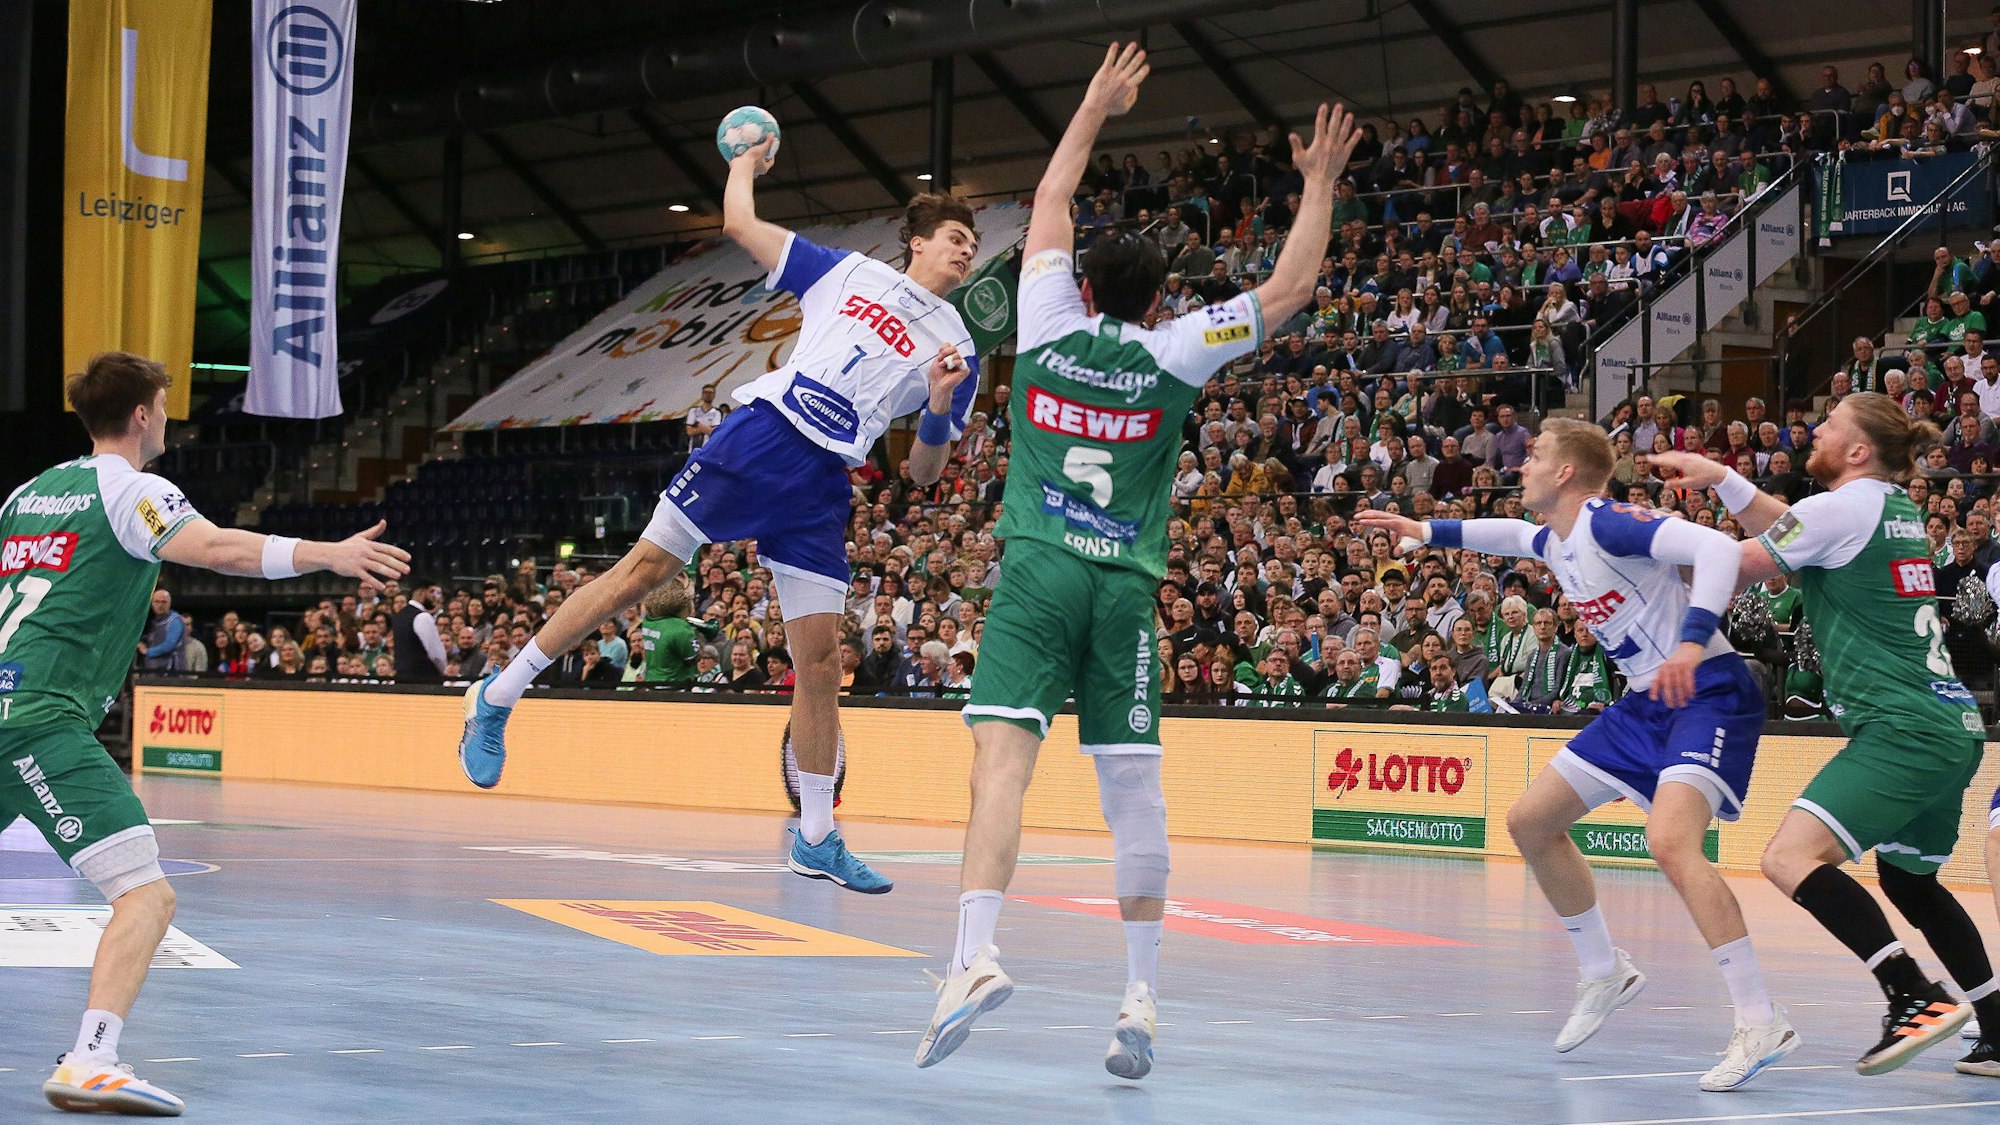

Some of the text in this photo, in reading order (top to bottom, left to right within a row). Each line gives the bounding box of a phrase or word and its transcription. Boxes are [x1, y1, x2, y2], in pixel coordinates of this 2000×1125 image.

[273, 115, 328, 369] Allianz
[1760, 223, 1785, 234] Allianz
[1709, 268, 1733, 279] Allianz
[1656, 312, 1681, 322] Allianz
[841, 344, 868, 376] 7
[1601, 357, 1627, 368] Allianz
[801, 393, 854, 430] SCHWALBE
[1033, 393, 1152, 440] REWE
[1062, 446, 1114, 508] 5
[682, 489, 700, 508] 7
[2, 535, 68, 571] REWE
[1898, 562, 1936, 593] RE
[1914, 604, 1956, 678] 2
[1133, 629, 1151, 701] Allianz
[168, 707, 215, 735] LOTTO
[12, 754, 63, 818] Allianz
[1368, 753, 1465, 795] LOTTO
[1366, 818, 1464, 842] SACHSENLOTTO
[1585, 830, 1650, 853] SACHSEN
